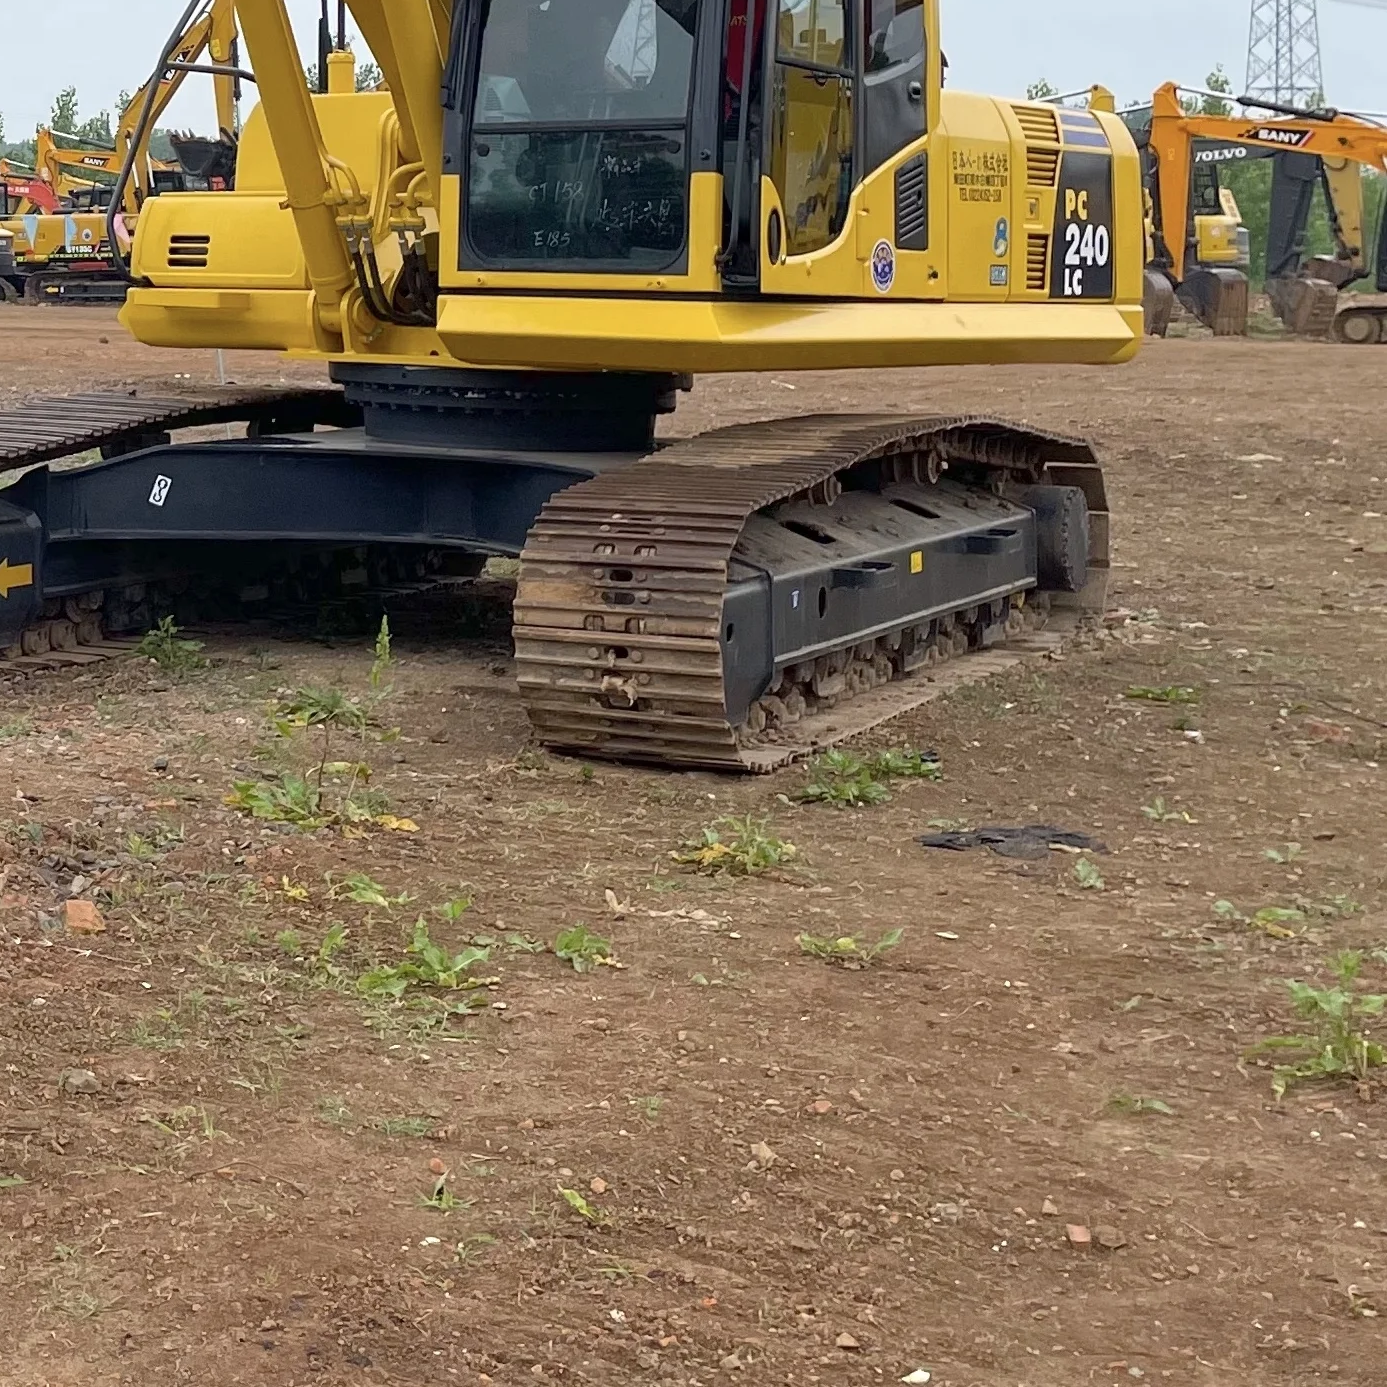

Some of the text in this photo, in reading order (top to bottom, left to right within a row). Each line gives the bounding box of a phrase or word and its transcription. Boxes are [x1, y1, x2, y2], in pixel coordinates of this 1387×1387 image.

[1257, 129, 1302, 144] SANY
[83, 157, 105, 167] SANY
[1065, 189, 1087, 220] PC
[1065, 223, 1109, 266] 240
[1063, 268, 1083, 296] LC
